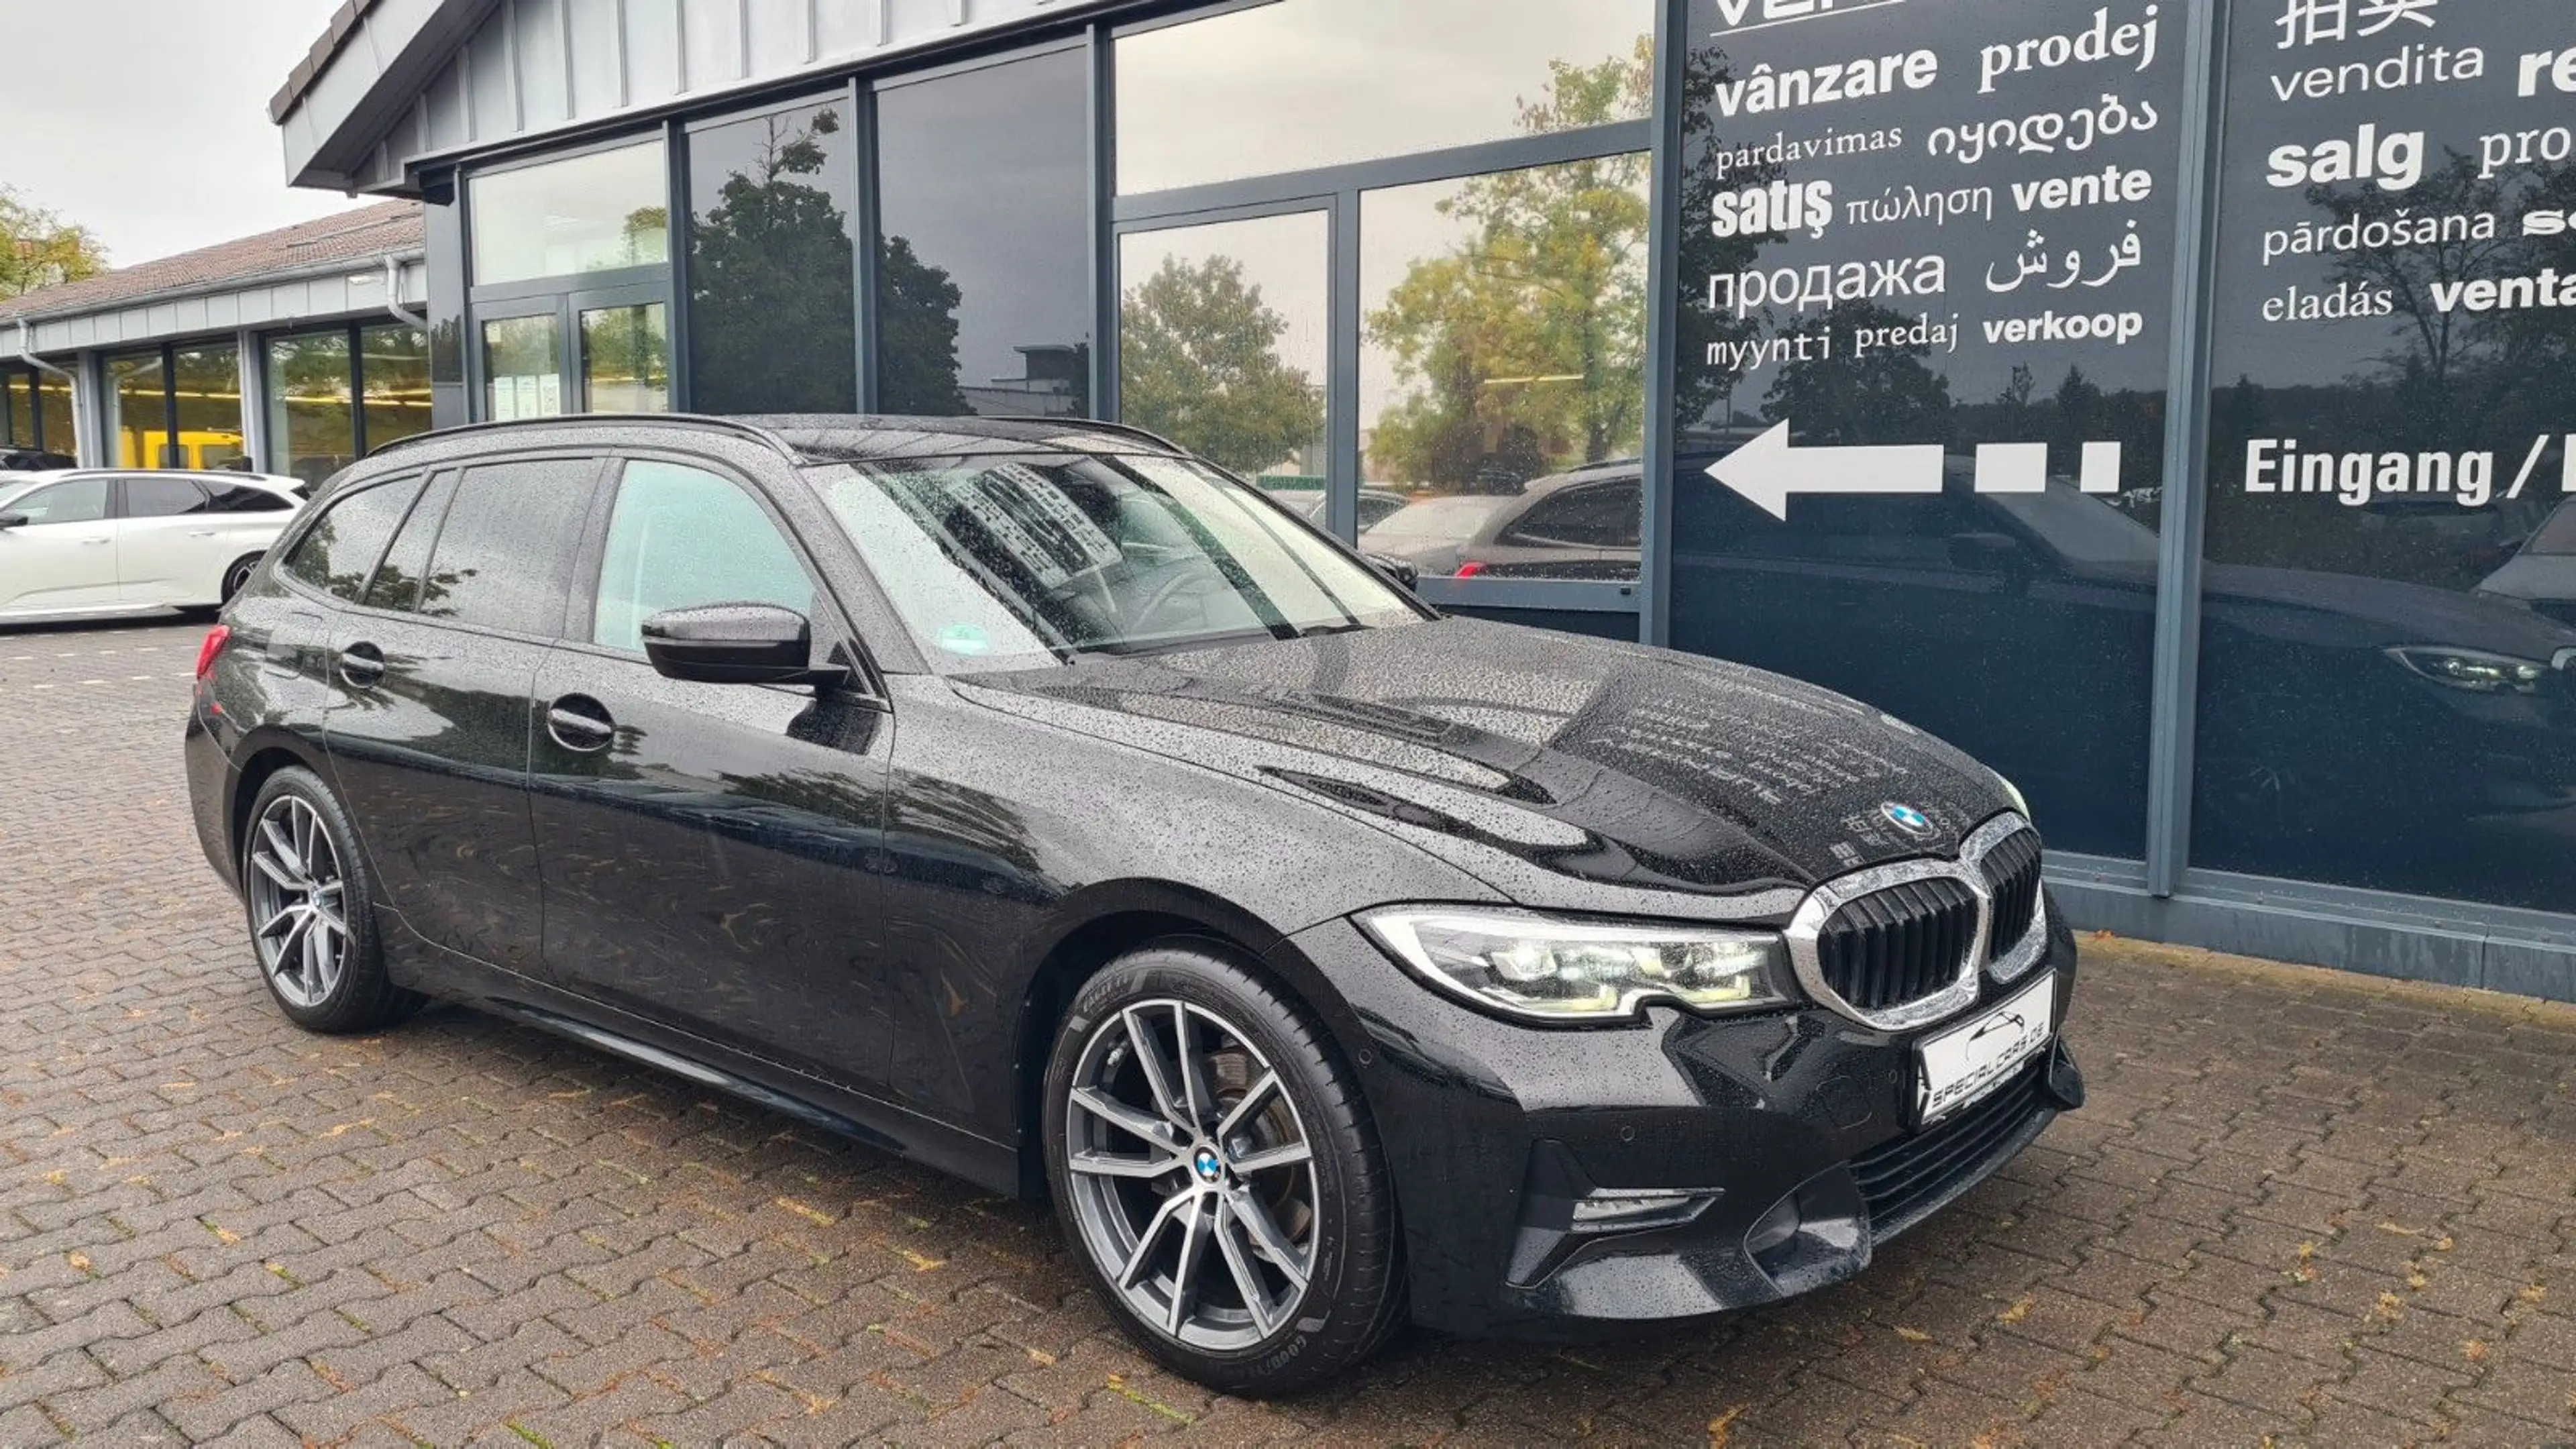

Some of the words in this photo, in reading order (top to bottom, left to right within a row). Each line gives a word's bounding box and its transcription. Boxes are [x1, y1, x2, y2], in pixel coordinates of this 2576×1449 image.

[1715, 49, 1938, 117] vânzare
[1977, 4, 2158, 94] prodej
[2270, 44, 2484, 101] vendita
[1717, 127, 1903, 180] pardavimas
[1927, 93, 2158, 164] იყიდება
[2265, 123, 2424, 191] salg
[2477, 127, 2571, 179] pro
[1711, 179, 1833, 239] satış
[1846, 185, 1992, 226] πώληση
[2012, 165, 2152, 211] vente
[1986, 218, 2141, 292] فروش
[2263, 208, 2495, 266] pārdošana
[1709, 255, 1945, 319] продажа
[2263, 281, 2393, 321] eladás
[1707, 327, 1830, 371] myynti
[1855, 312, 1959, 358] predaj
[1983, 310, 2143, 345] verkoop
[2245, 439, 2493, 506] Eingang
